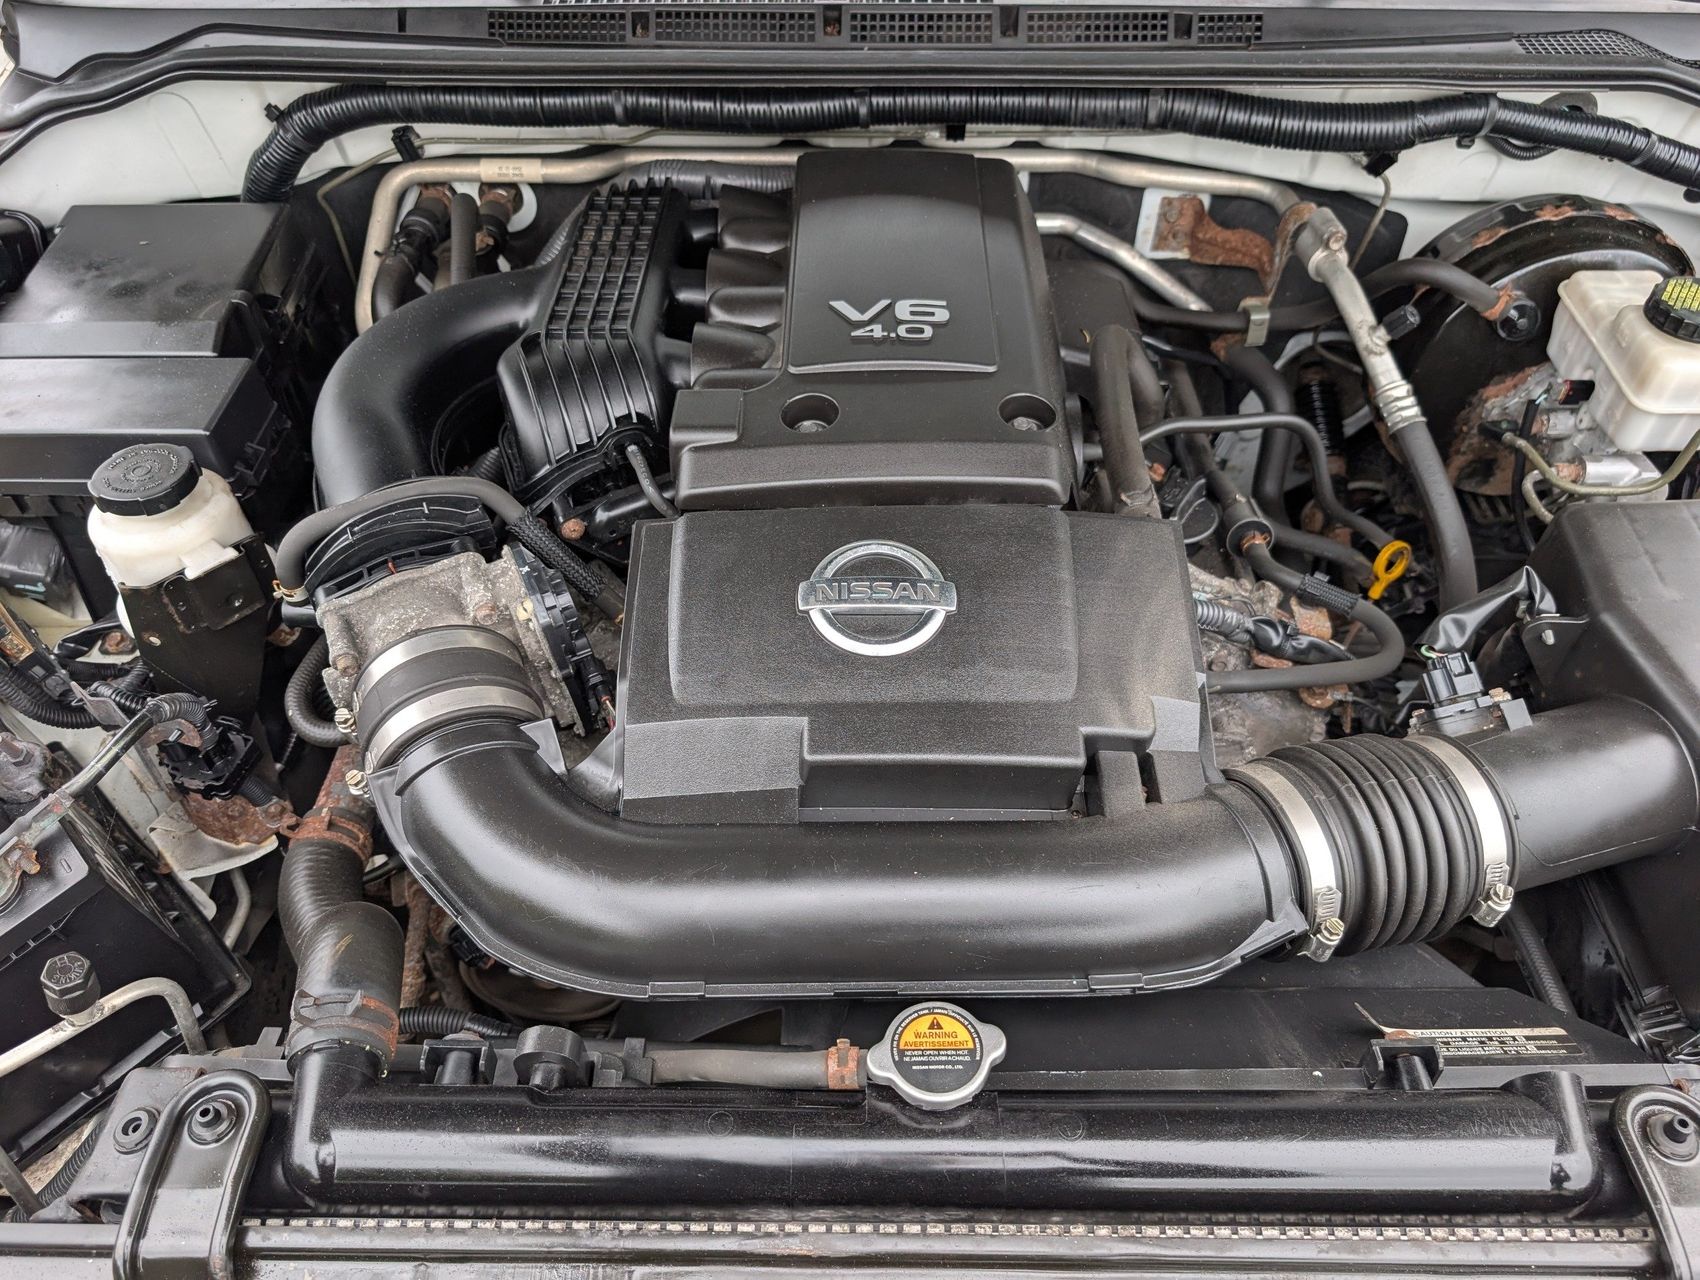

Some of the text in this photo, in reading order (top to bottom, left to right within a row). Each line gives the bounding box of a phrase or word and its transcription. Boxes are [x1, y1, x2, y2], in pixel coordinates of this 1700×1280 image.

[829, 299, 950, 323] V6
[851, 324, 934, 340] 4.0
[815, 582, 941, 601] NISSAN
[914, 1031, 958, 1039] WARNING
